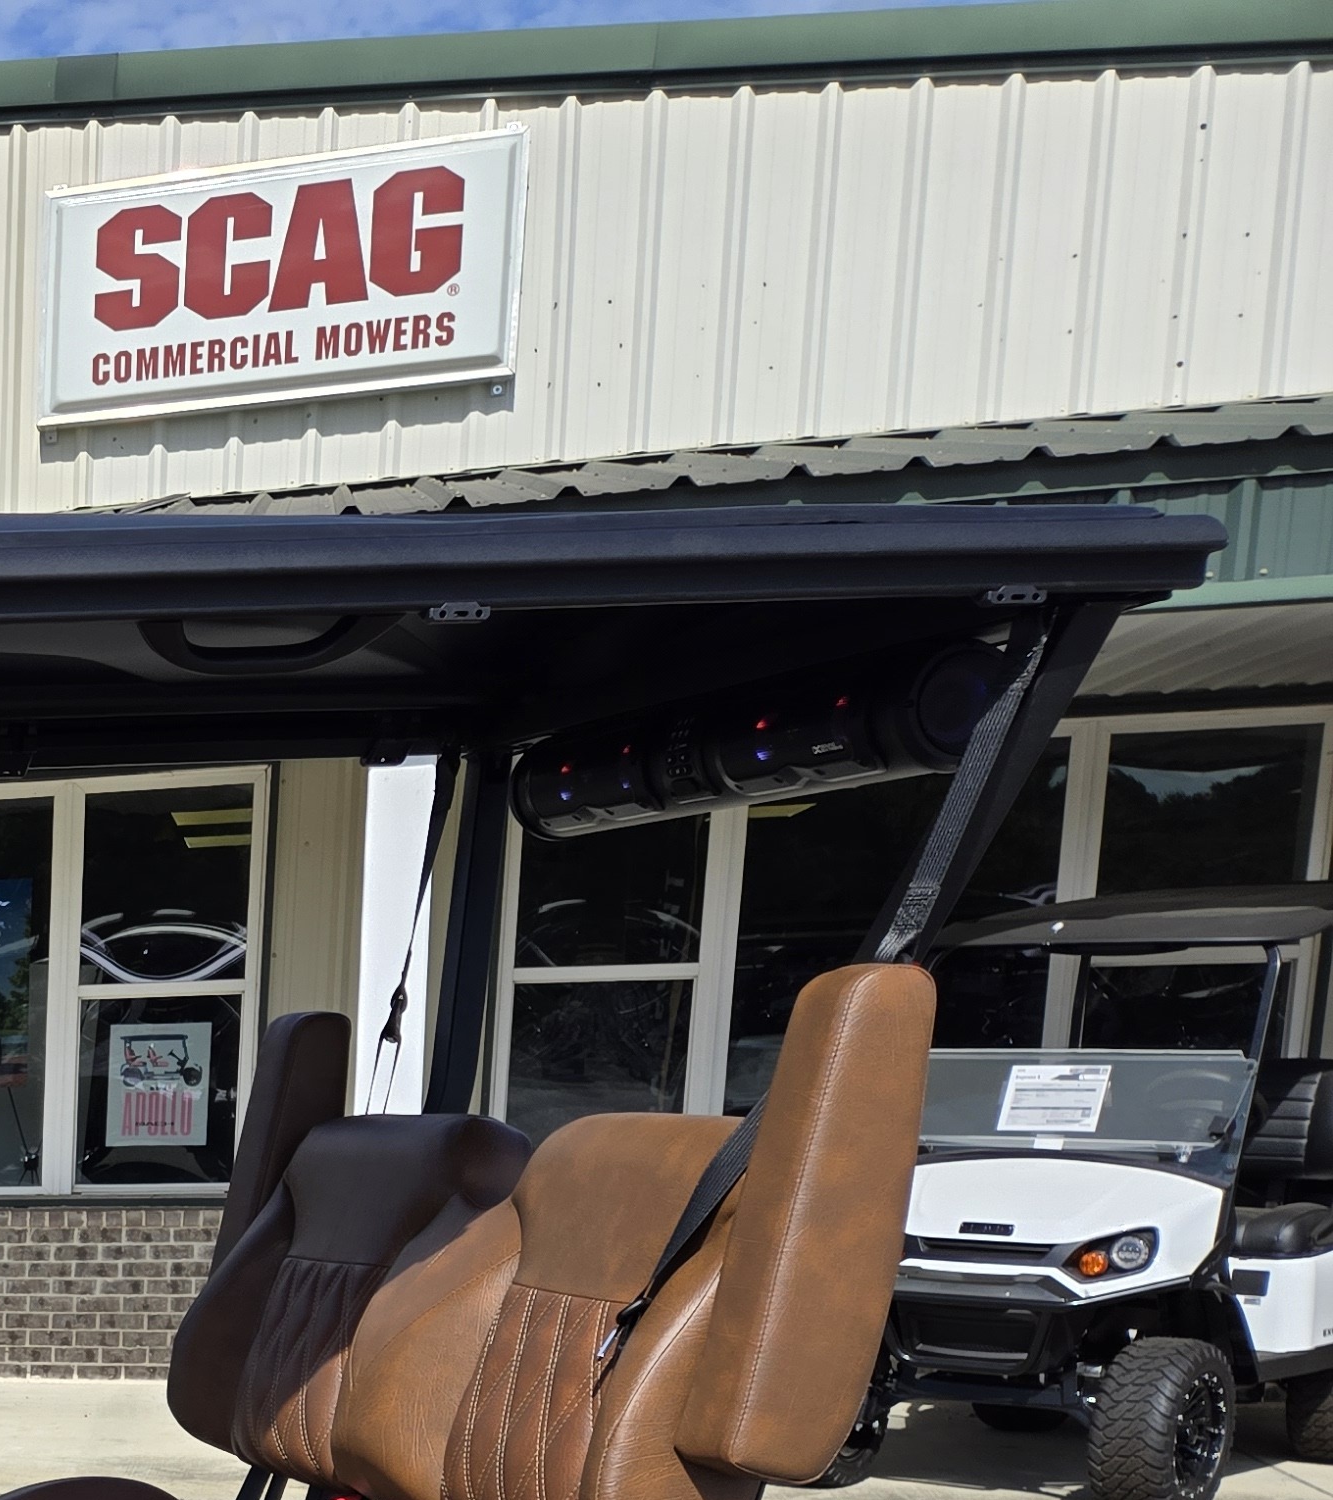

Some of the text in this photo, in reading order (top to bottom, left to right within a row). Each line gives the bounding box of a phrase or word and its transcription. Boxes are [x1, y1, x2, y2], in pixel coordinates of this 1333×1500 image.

[94, 165, 465, 332] SCAG
[91, 311, 456, 386] COMMERCIAL MOWERS
[121, 1091, 192, 1136] APOLLO
